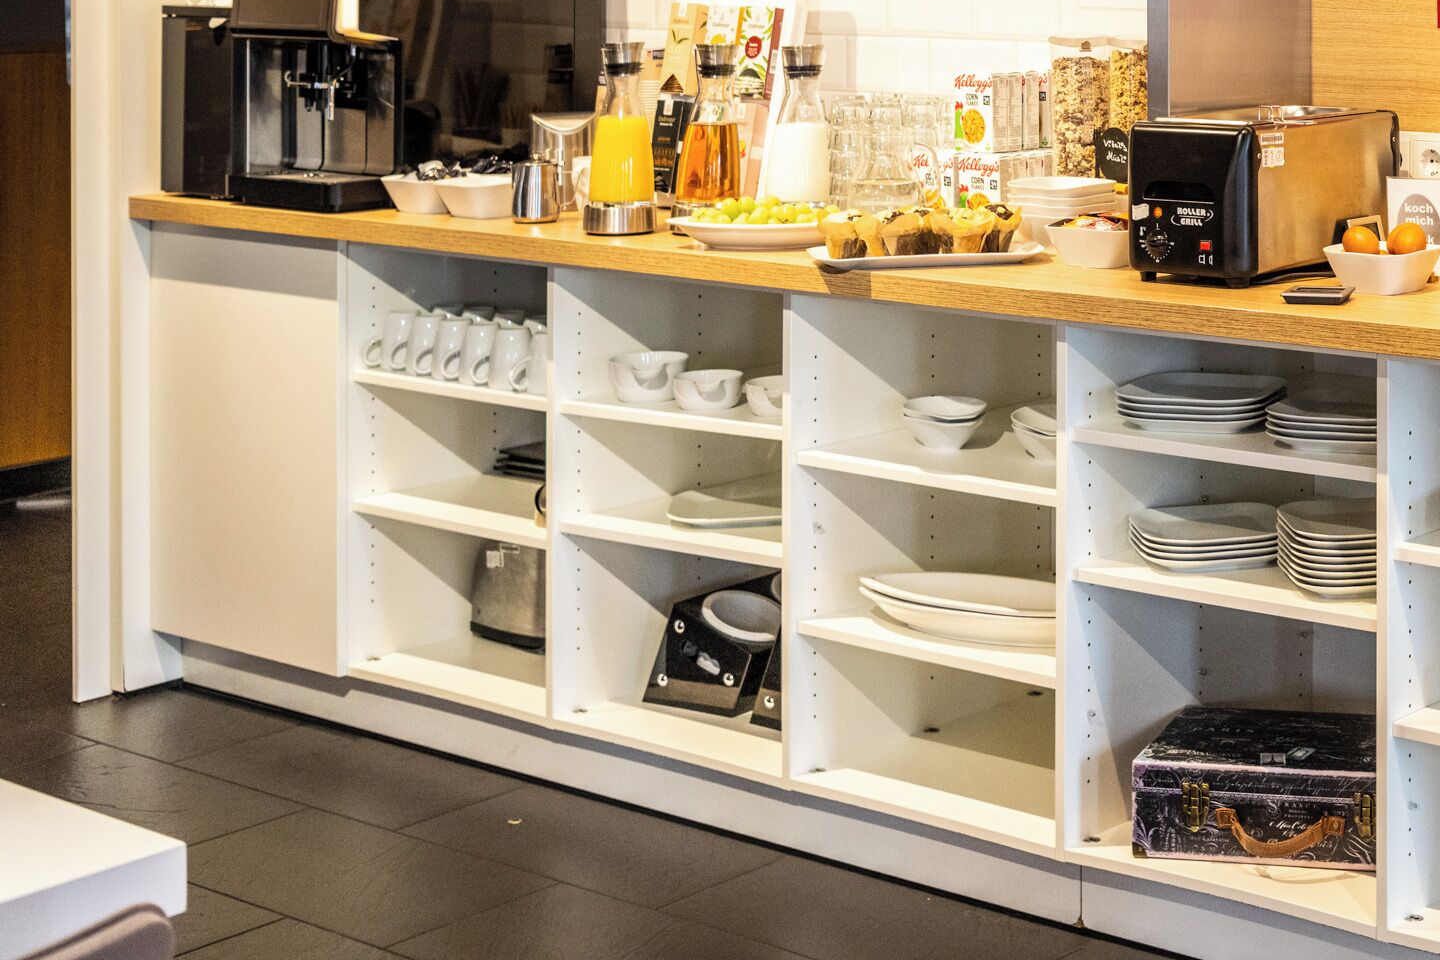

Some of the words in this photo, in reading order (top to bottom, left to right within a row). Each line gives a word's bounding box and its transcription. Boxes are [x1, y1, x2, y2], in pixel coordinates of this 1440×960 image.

[954, 73, 993, 94] Kellogg's
[965, 93, 979, 101] CORN
[959, 156, 1000, 177] Kellogg's
[970, 176, 985, 185] CORN
[1177, 207, 1206, 217] ROLLER
[1404, 203, 1434, 214] koch
[1180, 217, 1203, 227] GRILL
[1405, 215, 1434, 226] mich
